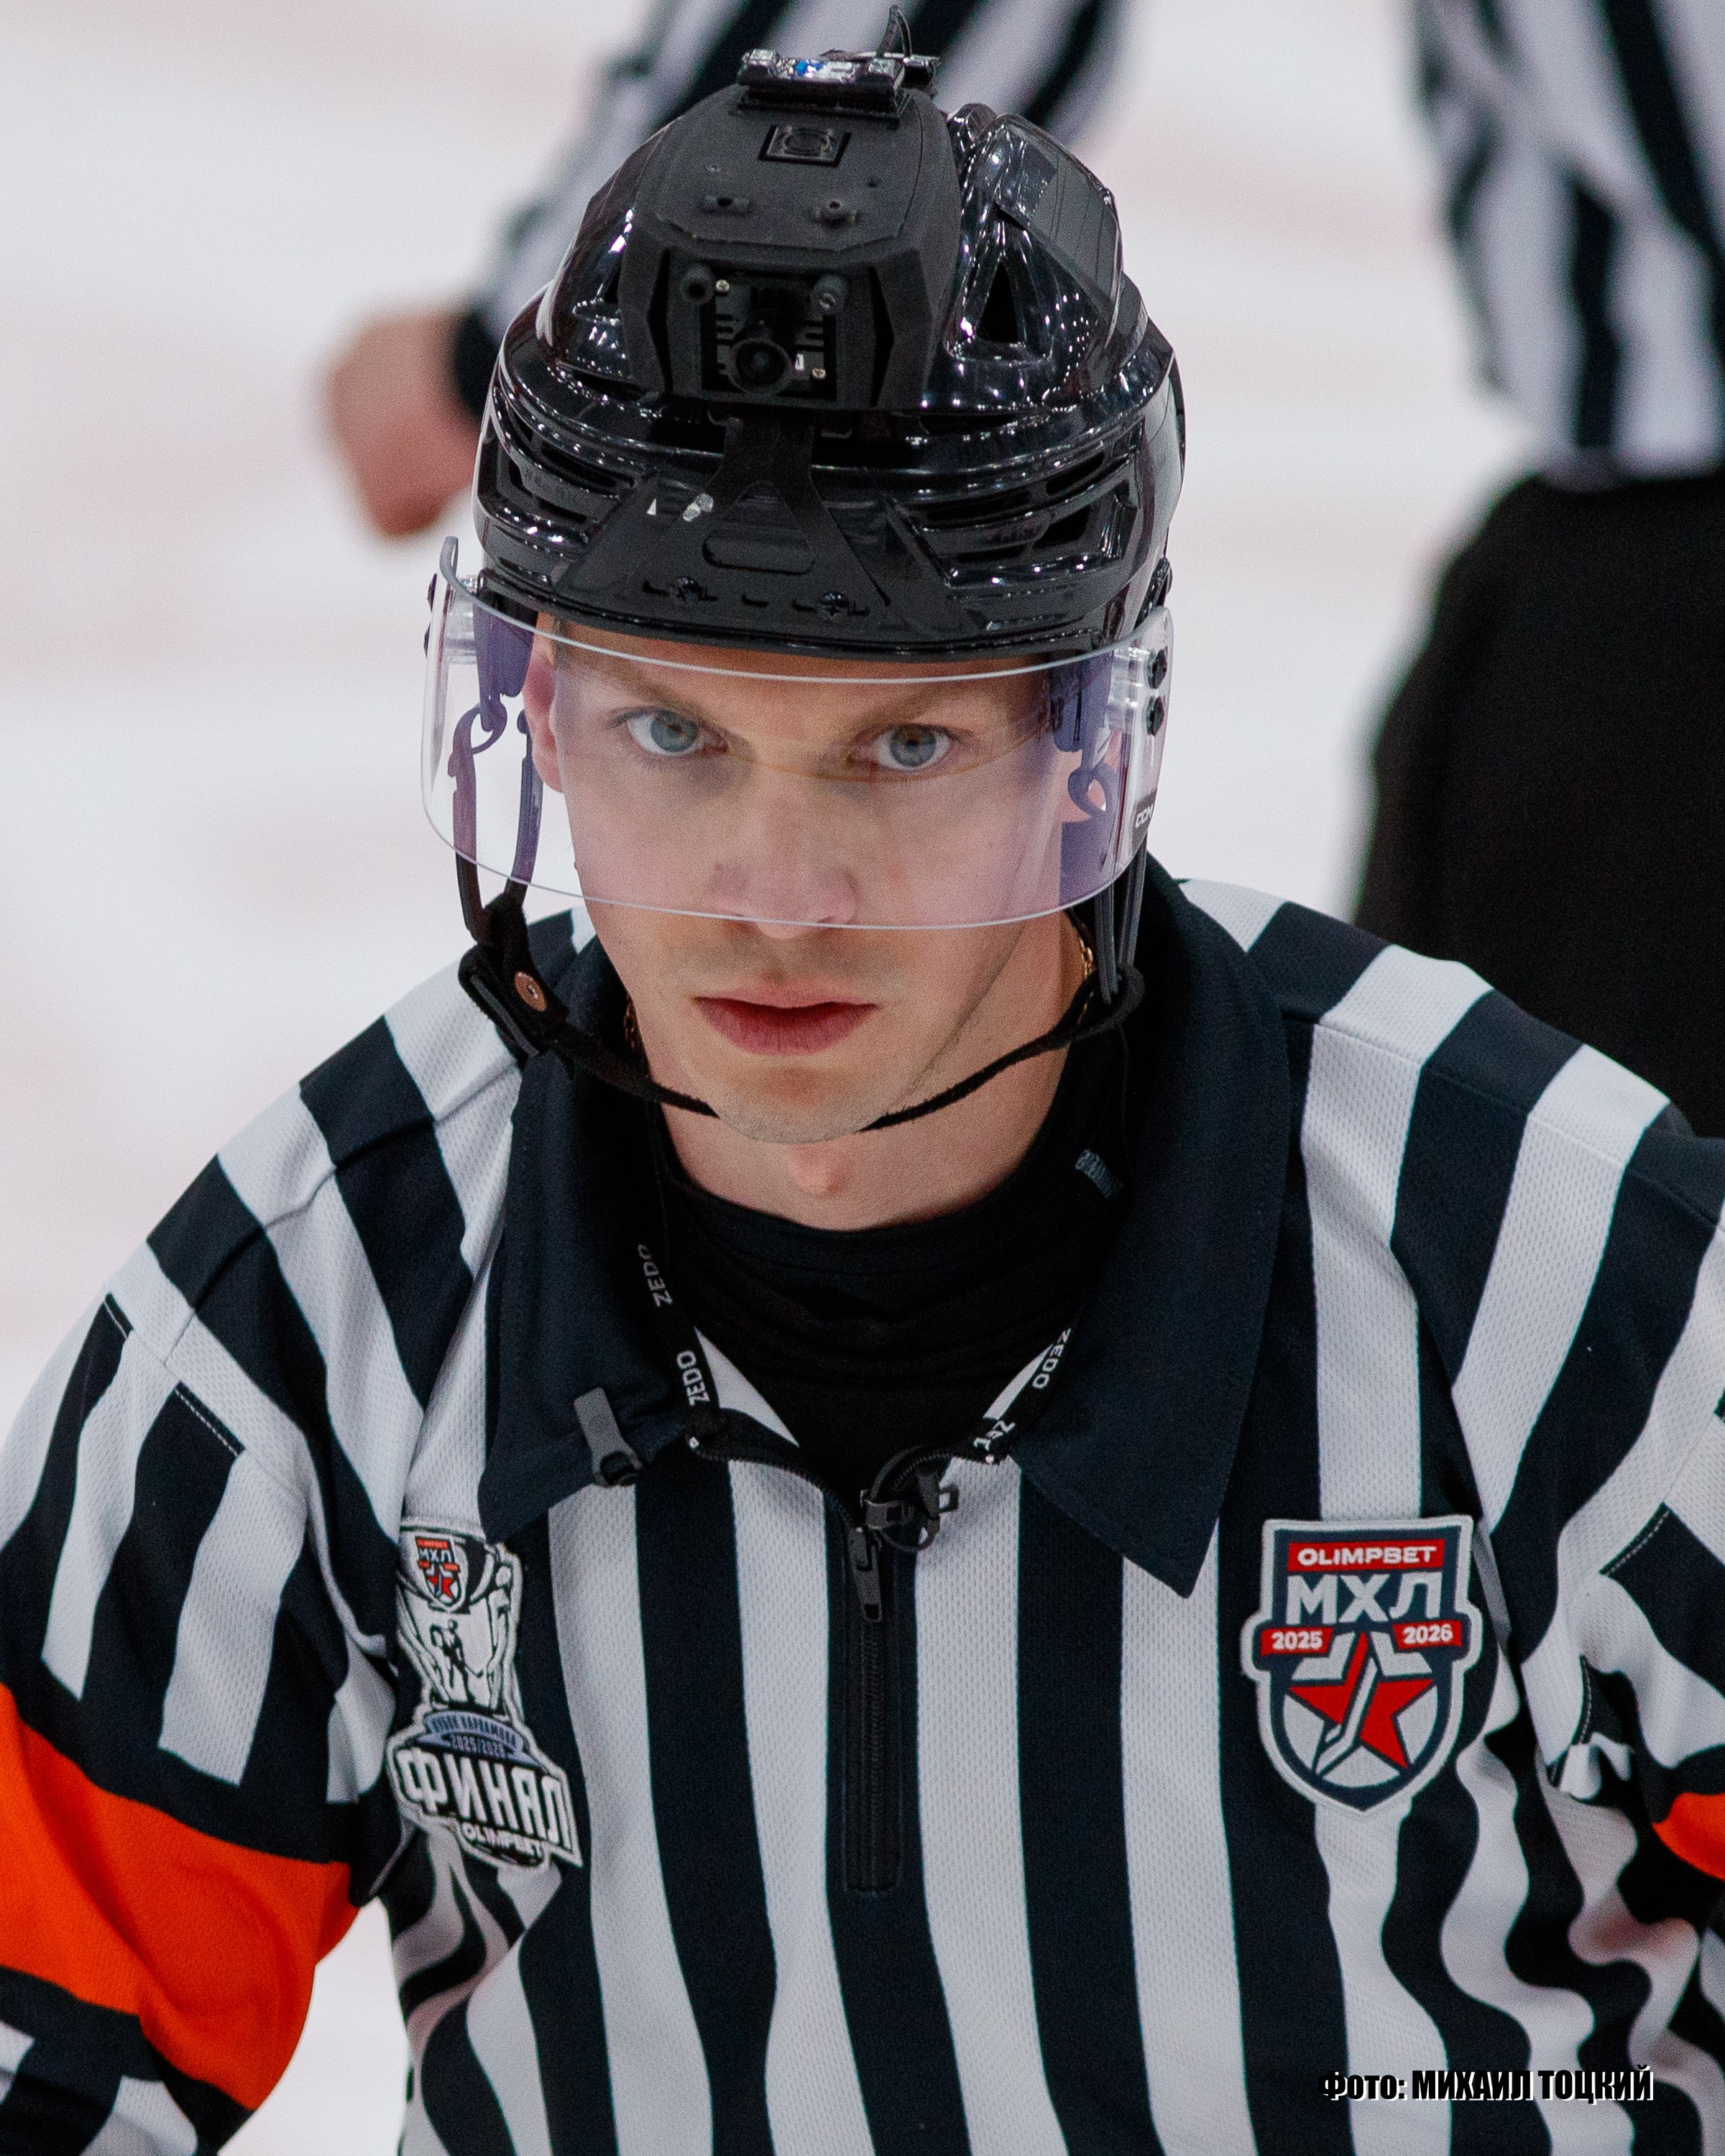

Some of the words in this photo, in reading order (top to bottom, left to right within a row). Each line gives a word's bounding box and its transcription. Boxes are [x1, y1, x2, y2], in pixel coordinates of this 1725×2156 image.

[676, 1350, 711, 1406] ZEDO
[1032, 1328, 1072, 1388] ZEDO
[1297, 1546, 1437, 1566] OLIMPBET
[1285, 1571, 1443, 1626] МХЛ
[1271, 1631, 1323, 1651] 2025
[1402, 1623, 1453, 1644] 2026
[397, 1747, 571, 1850] ФИНАЛ
